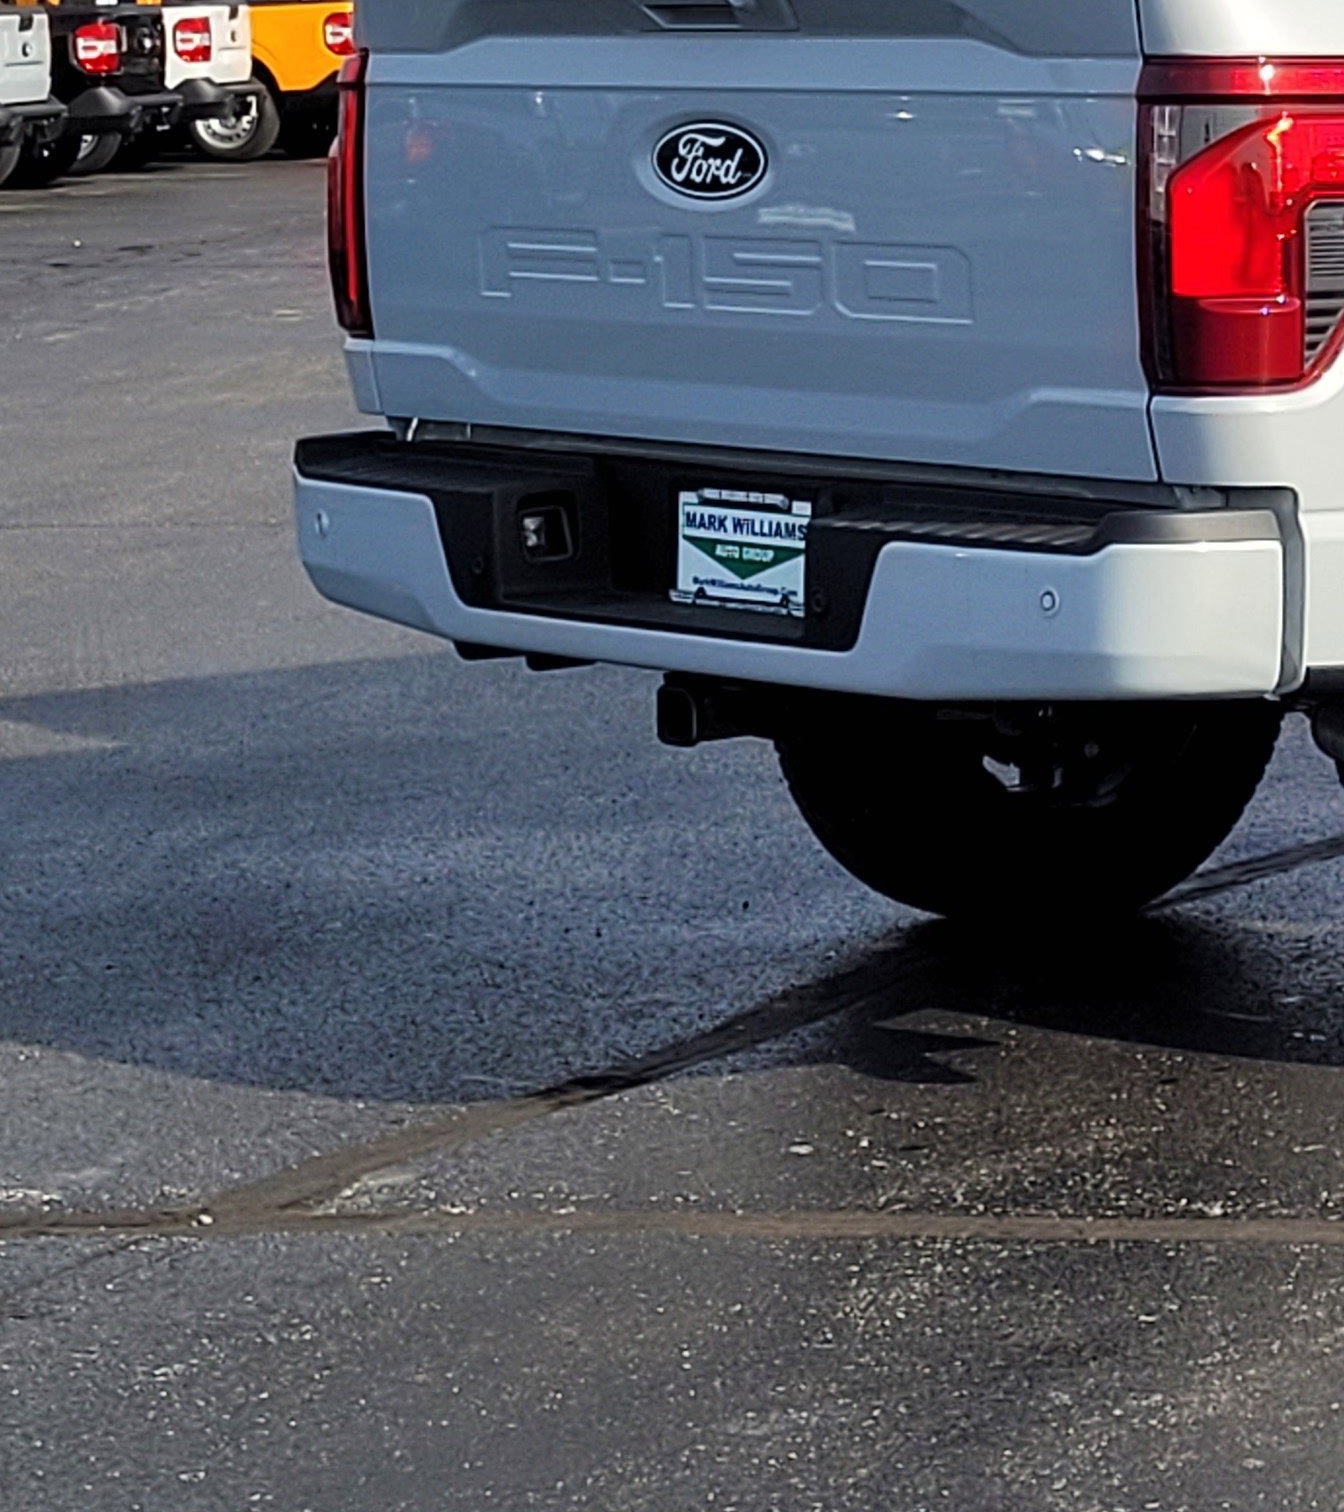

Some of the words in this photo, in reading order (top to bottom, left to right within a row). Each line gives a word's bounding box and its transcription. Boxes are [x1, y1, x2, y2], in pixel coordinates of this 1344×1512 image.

[671, 132, 744, 185] Ford
[479, 225, 974, 326] F-150
[685, 511, 728, 534] MARK
[732, 516, 808, 541] WILLIAMS
